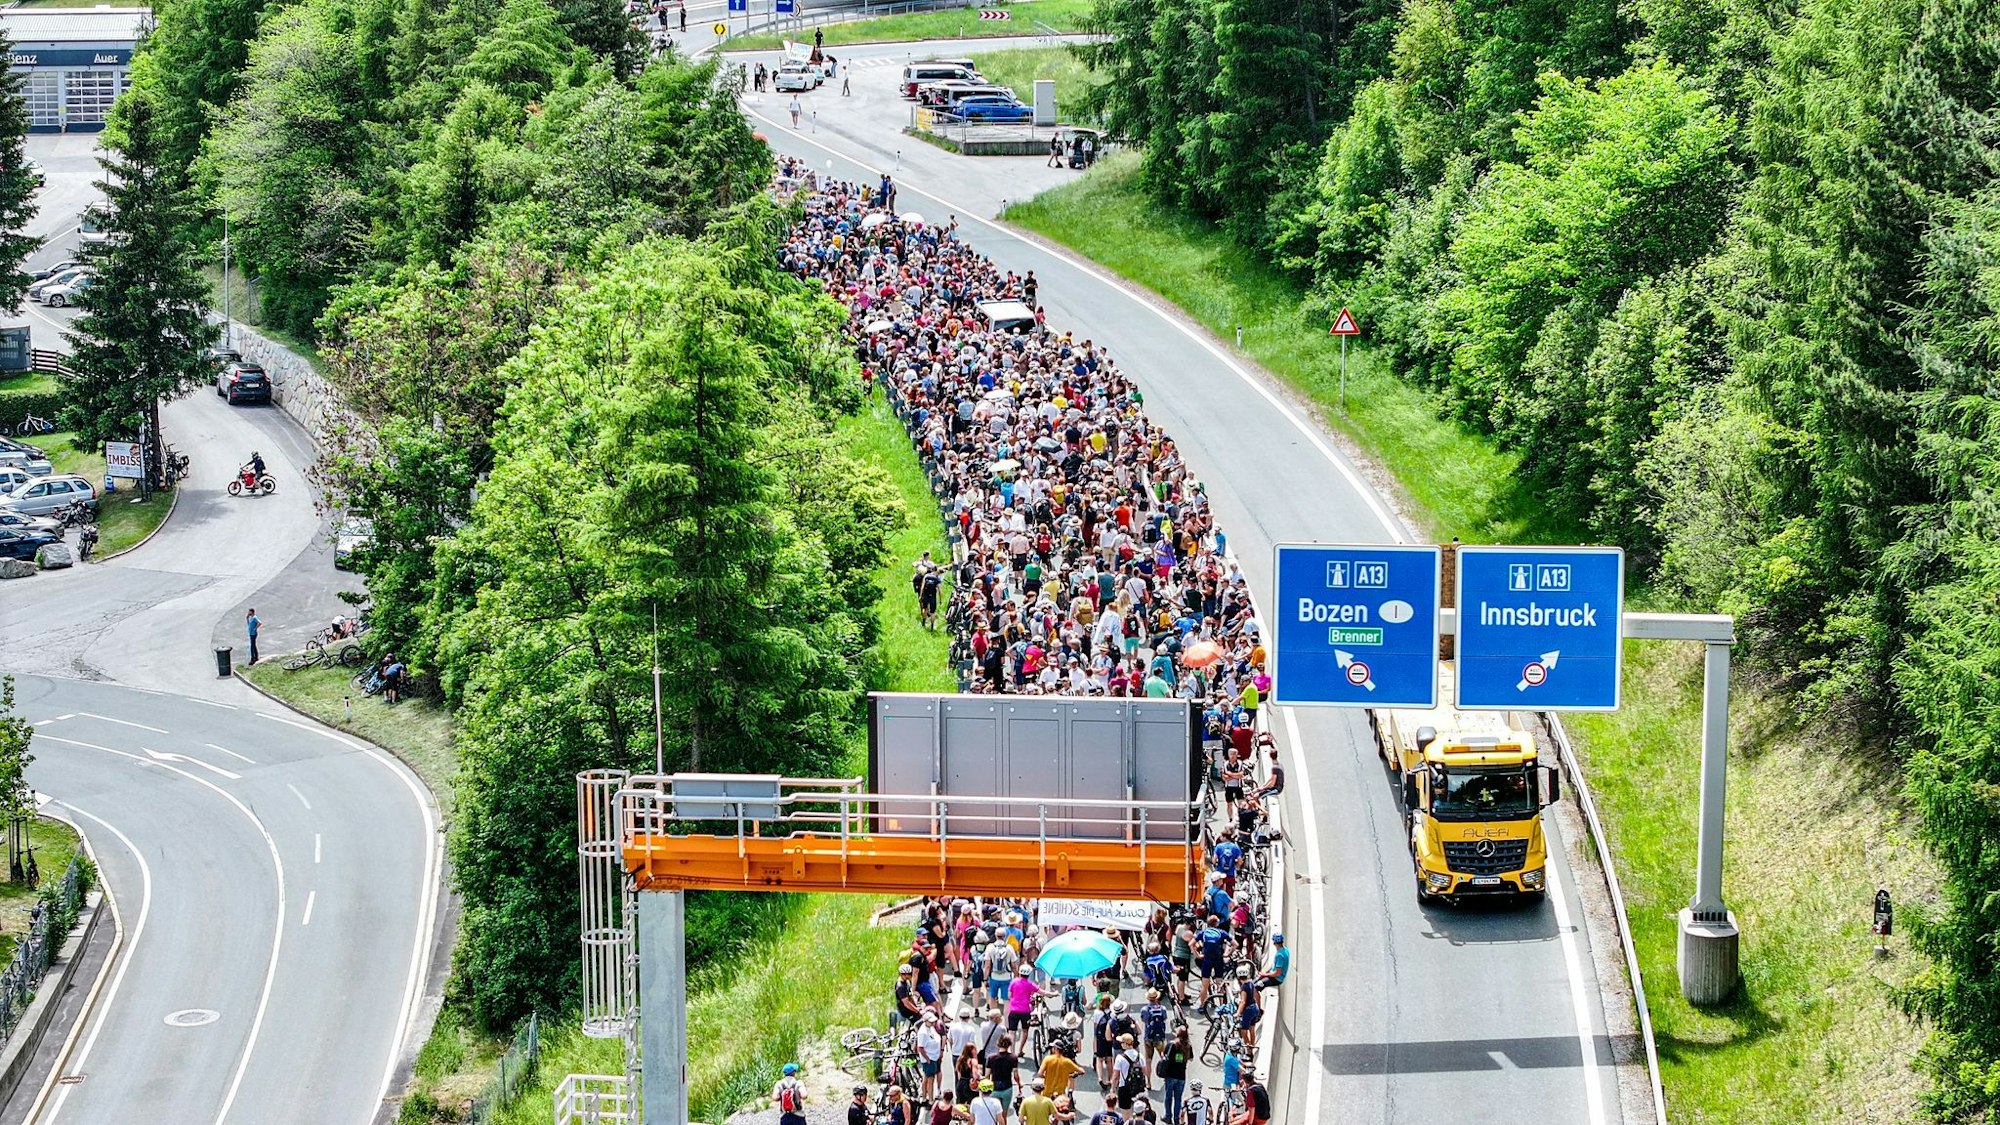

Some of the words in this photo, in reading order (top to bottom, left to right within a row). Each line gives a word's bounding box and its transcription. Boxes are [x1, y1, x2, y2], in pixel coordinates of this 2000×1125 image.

[0, 53, 37, 65] -Benz
[94, 53, 118, 64] Auer
[108, 454, 141, 466] IMBISS
[1358, 566, 1384, 584] A13
[1541, 568, 1567, 587] A13
[1299, 598, 1368, 623] Bozen
[1481, 601, 1597, 626] Innsbruck
[1331, 629, 1380, 643] Brenner
